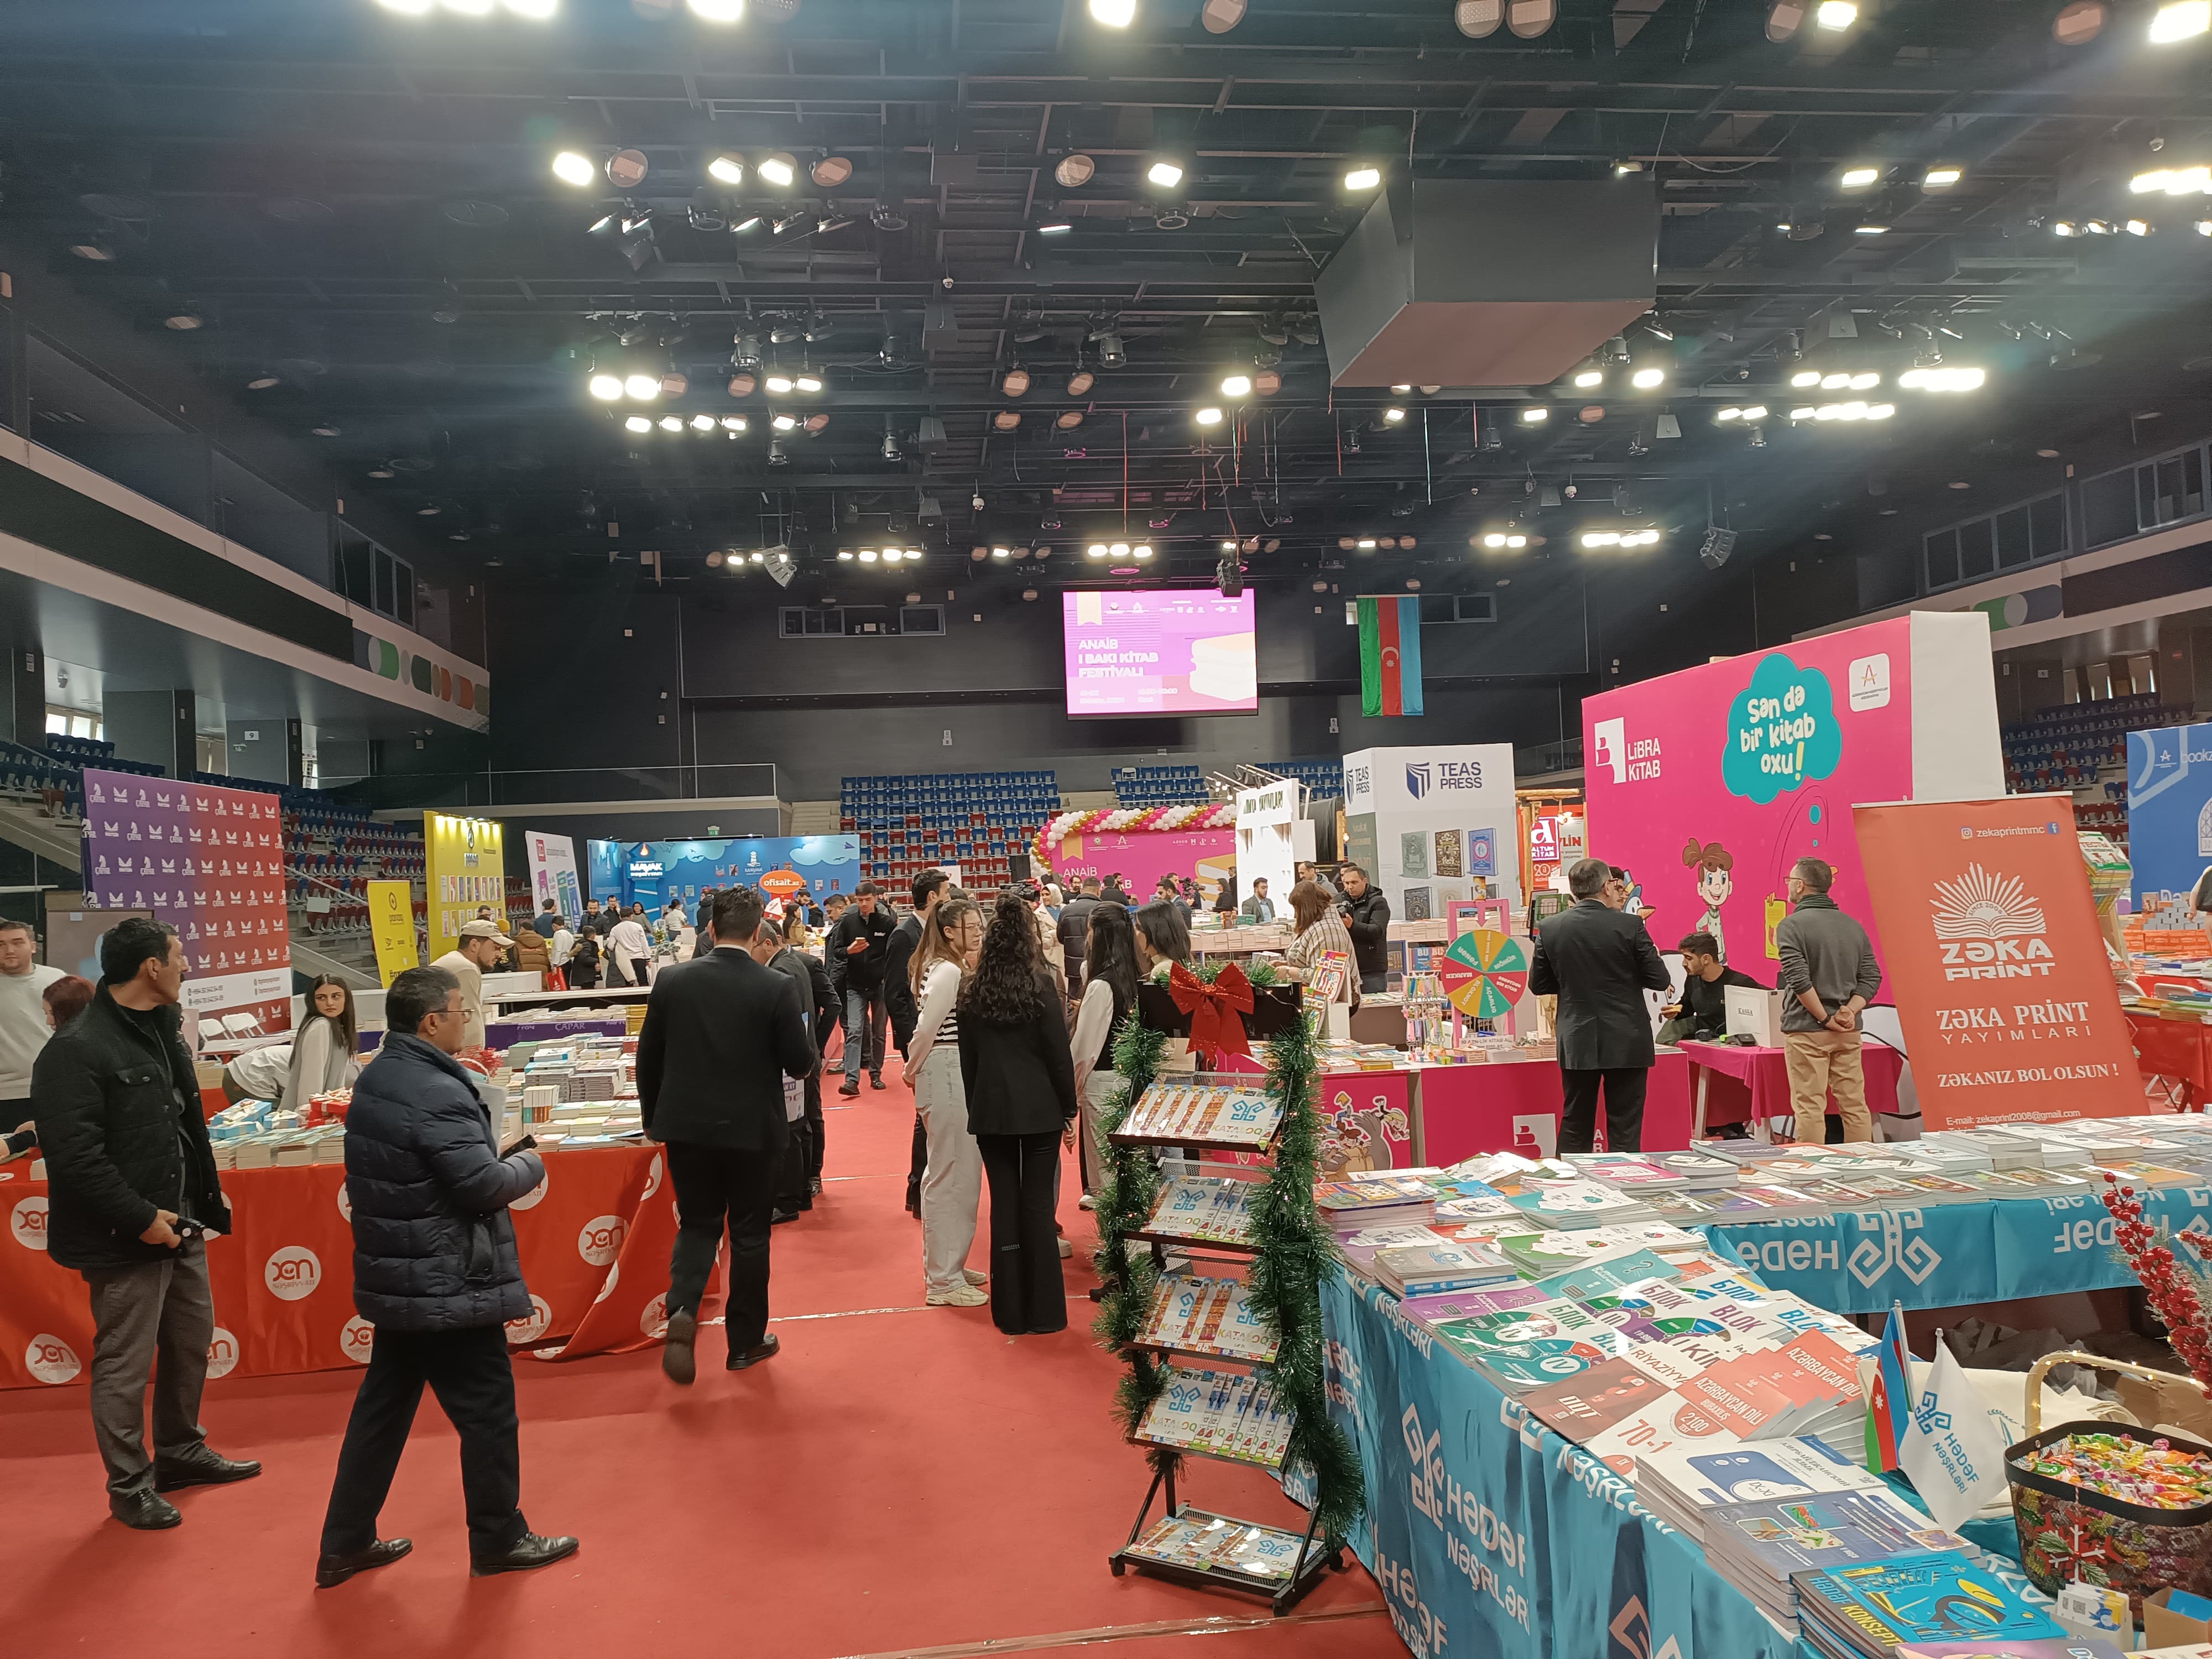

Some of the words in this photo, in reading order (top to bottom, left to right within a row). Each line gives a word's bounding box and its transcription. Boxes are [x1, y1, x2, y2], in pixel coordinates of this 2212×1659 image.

[1740, 727, 1763, 753] bir
[1769, 712, 1815, 748] kitab
[1355, 766, 1369, 781] TEAS
[1438, 762, 1481, 776] TEAS
[1356, 781, 1370, 794] PRESS
[1440, 777, 1483, 789] PRESS
[1976, 826, 2045, 838] zekaprintmmc
[1939, 938, 2054, 965] ZƏKA
[1944, 961, 2056, 982] PRİNT
[1936, 1007, 2006, 1030] ZƏKA
[2013, 999, 2089, 1025] PRİNT
[555, 1022, 586, 1032] ÇAPAR
[1942, 1025, 2091, 1045] YAYIMLARI
[1938, 1070, 2015, 1087] ZƏKANIZ
[2017, 1068, 2052, 1083] BOL
[2053, 1063, 2110, 1079] OLSUN
[1976, 1109, 2081, 1124] zekaprint2008@gmail.com
[1639, 1284, 1692, 1310] БЛОК
[1546, 1304, 1595, 1331] БЛОК
[1709, 1303, 1767, 1333] BLOK
[1785, 1347, 1843, 1390] AZƏRBAYCAN
[1696, 1376, 1752, 1421] AZƏRBAYCAN
[1743, 1409, 1769, 1426] DİLİ
[1677, 1423, 1693, 1434] TEST
[1679, 1410, 1709, 1433] 2100
[1932, 1442, 1970, 1495] NƏŞRLƏRİ
[1944, 1432, 1980, 1485] HƏDƏF
[1840, 1605, 1905, 1647] KONSEPT
